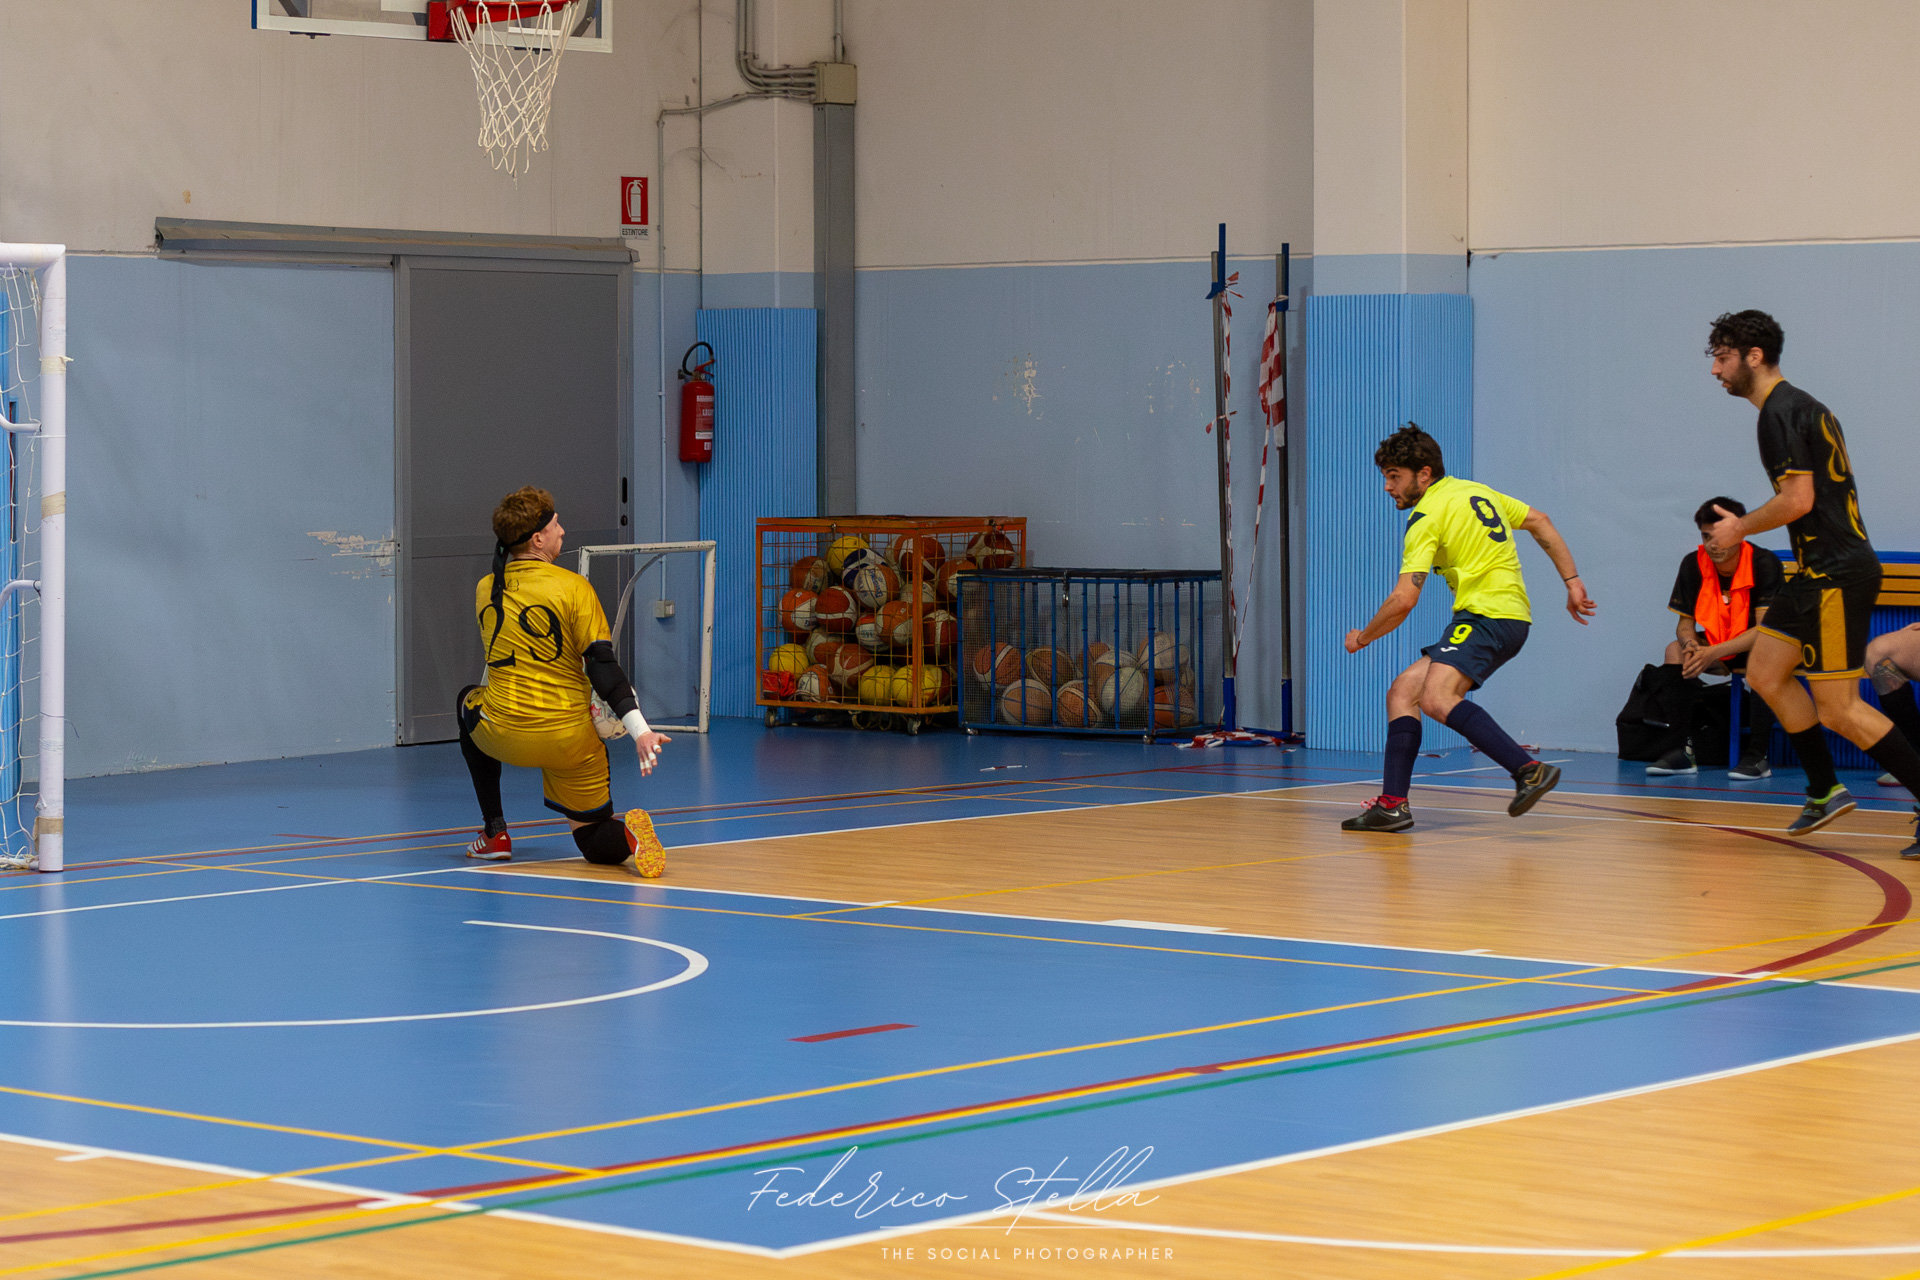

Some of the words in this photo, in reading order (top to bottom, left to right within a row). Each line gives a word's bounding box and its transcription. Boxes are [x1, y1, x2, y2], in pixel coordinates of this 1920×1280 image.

[621, 228, 649, 236] ESTINTORE
[1470, 495, 1508, 542] 9
[479, 603, 563, 668] 29
[1449, 623, 1473, 645] 9
